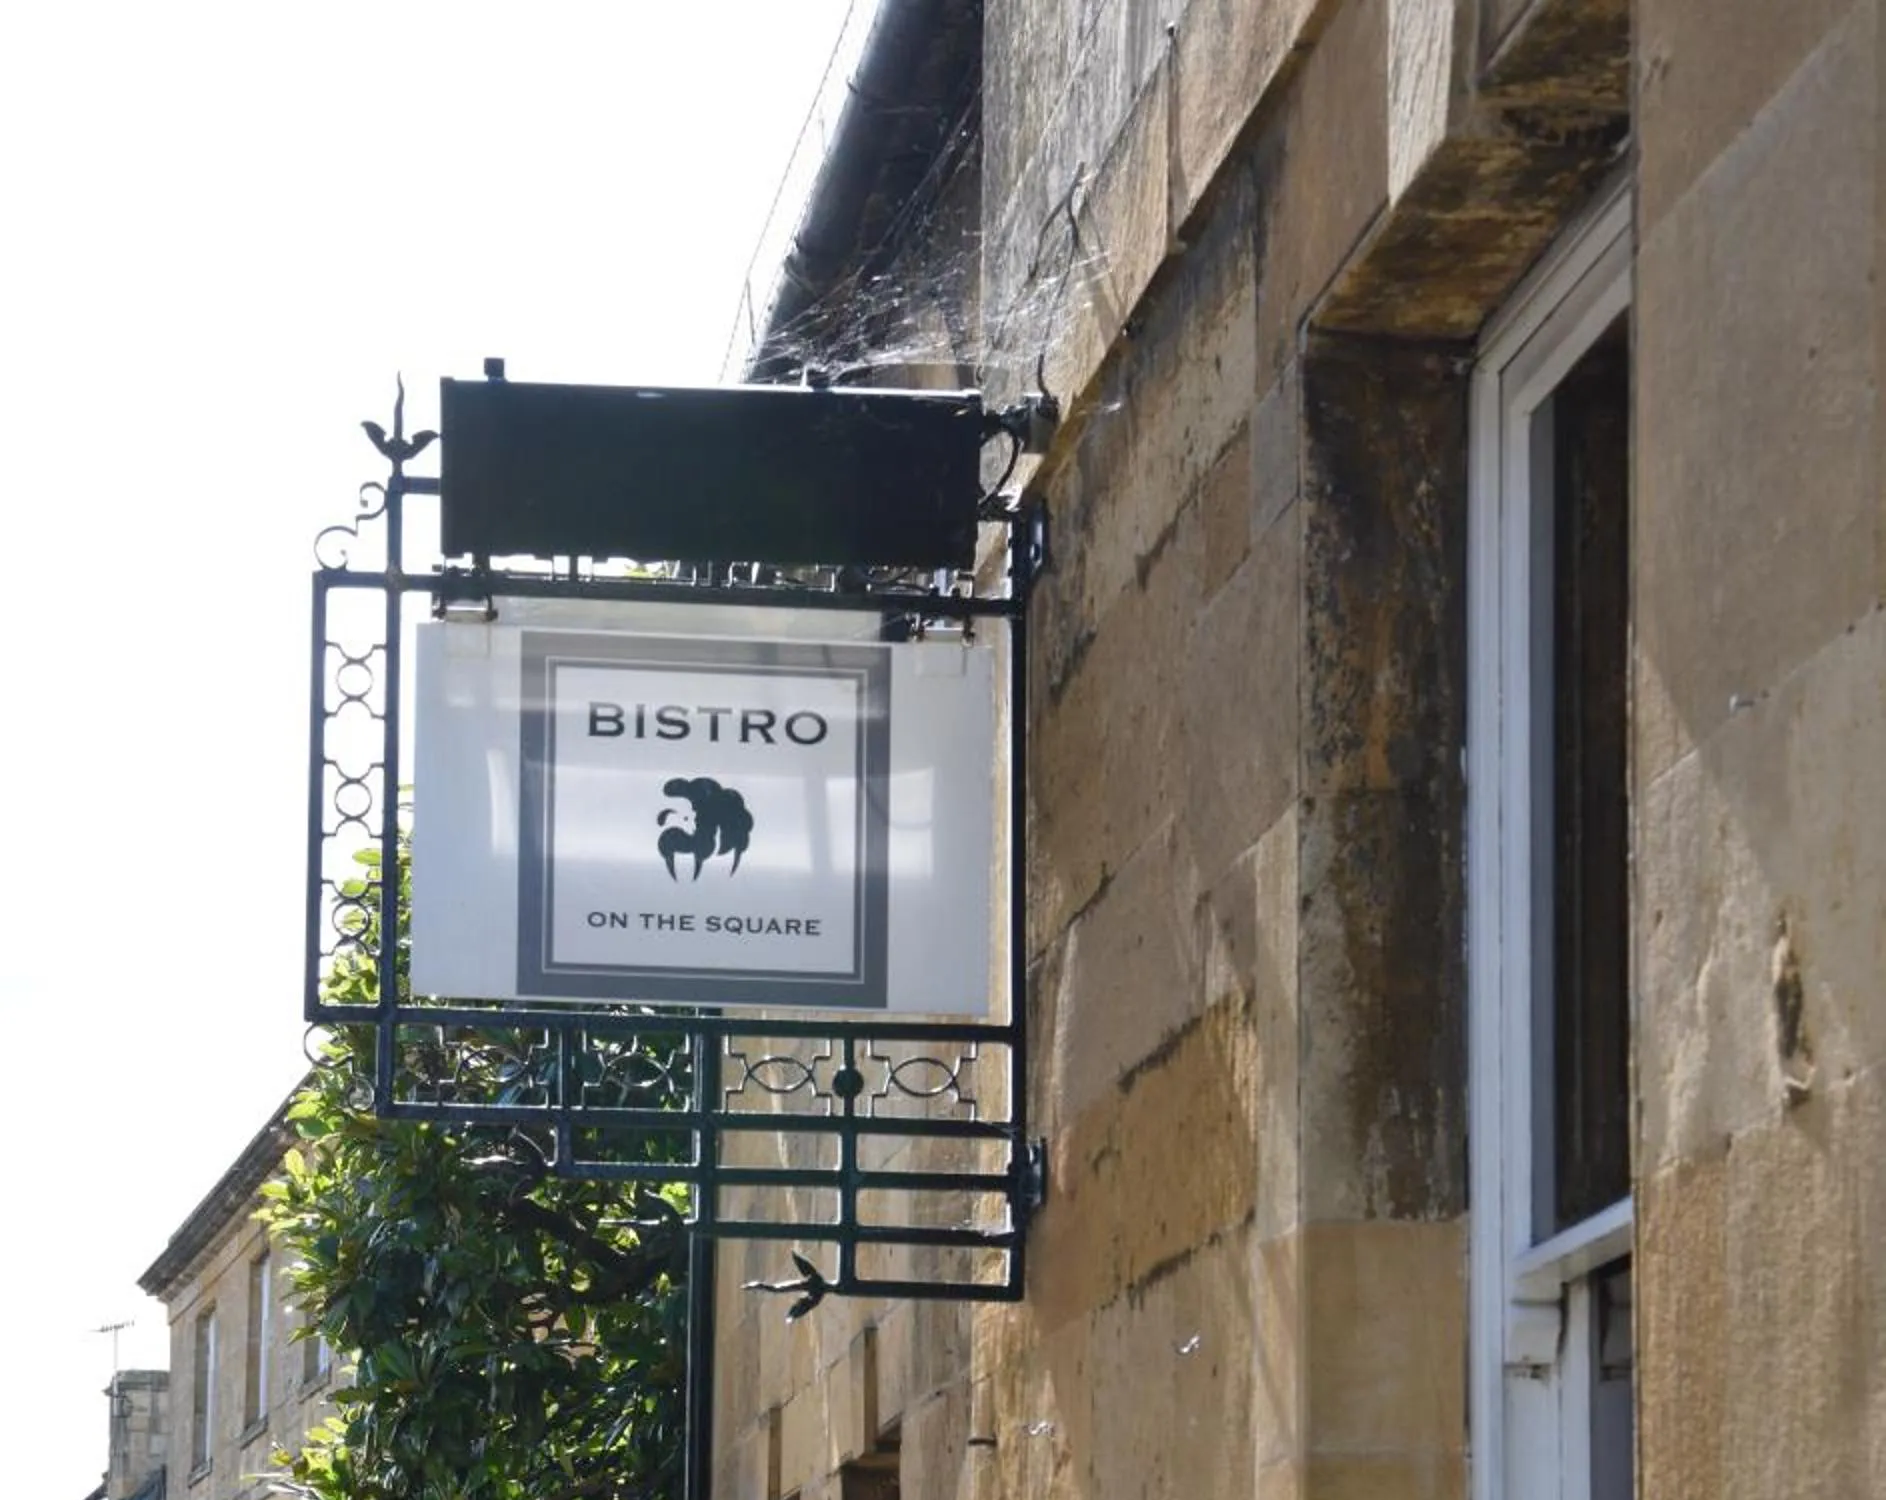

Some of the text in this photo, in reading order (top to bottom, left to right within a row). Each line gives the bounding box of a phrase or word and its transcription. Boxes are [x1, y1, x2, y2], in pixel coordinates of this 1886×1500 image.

[588, 701, 829, 746] BISTRO
[587, 911, 822, 937] ON THE SQUARE
